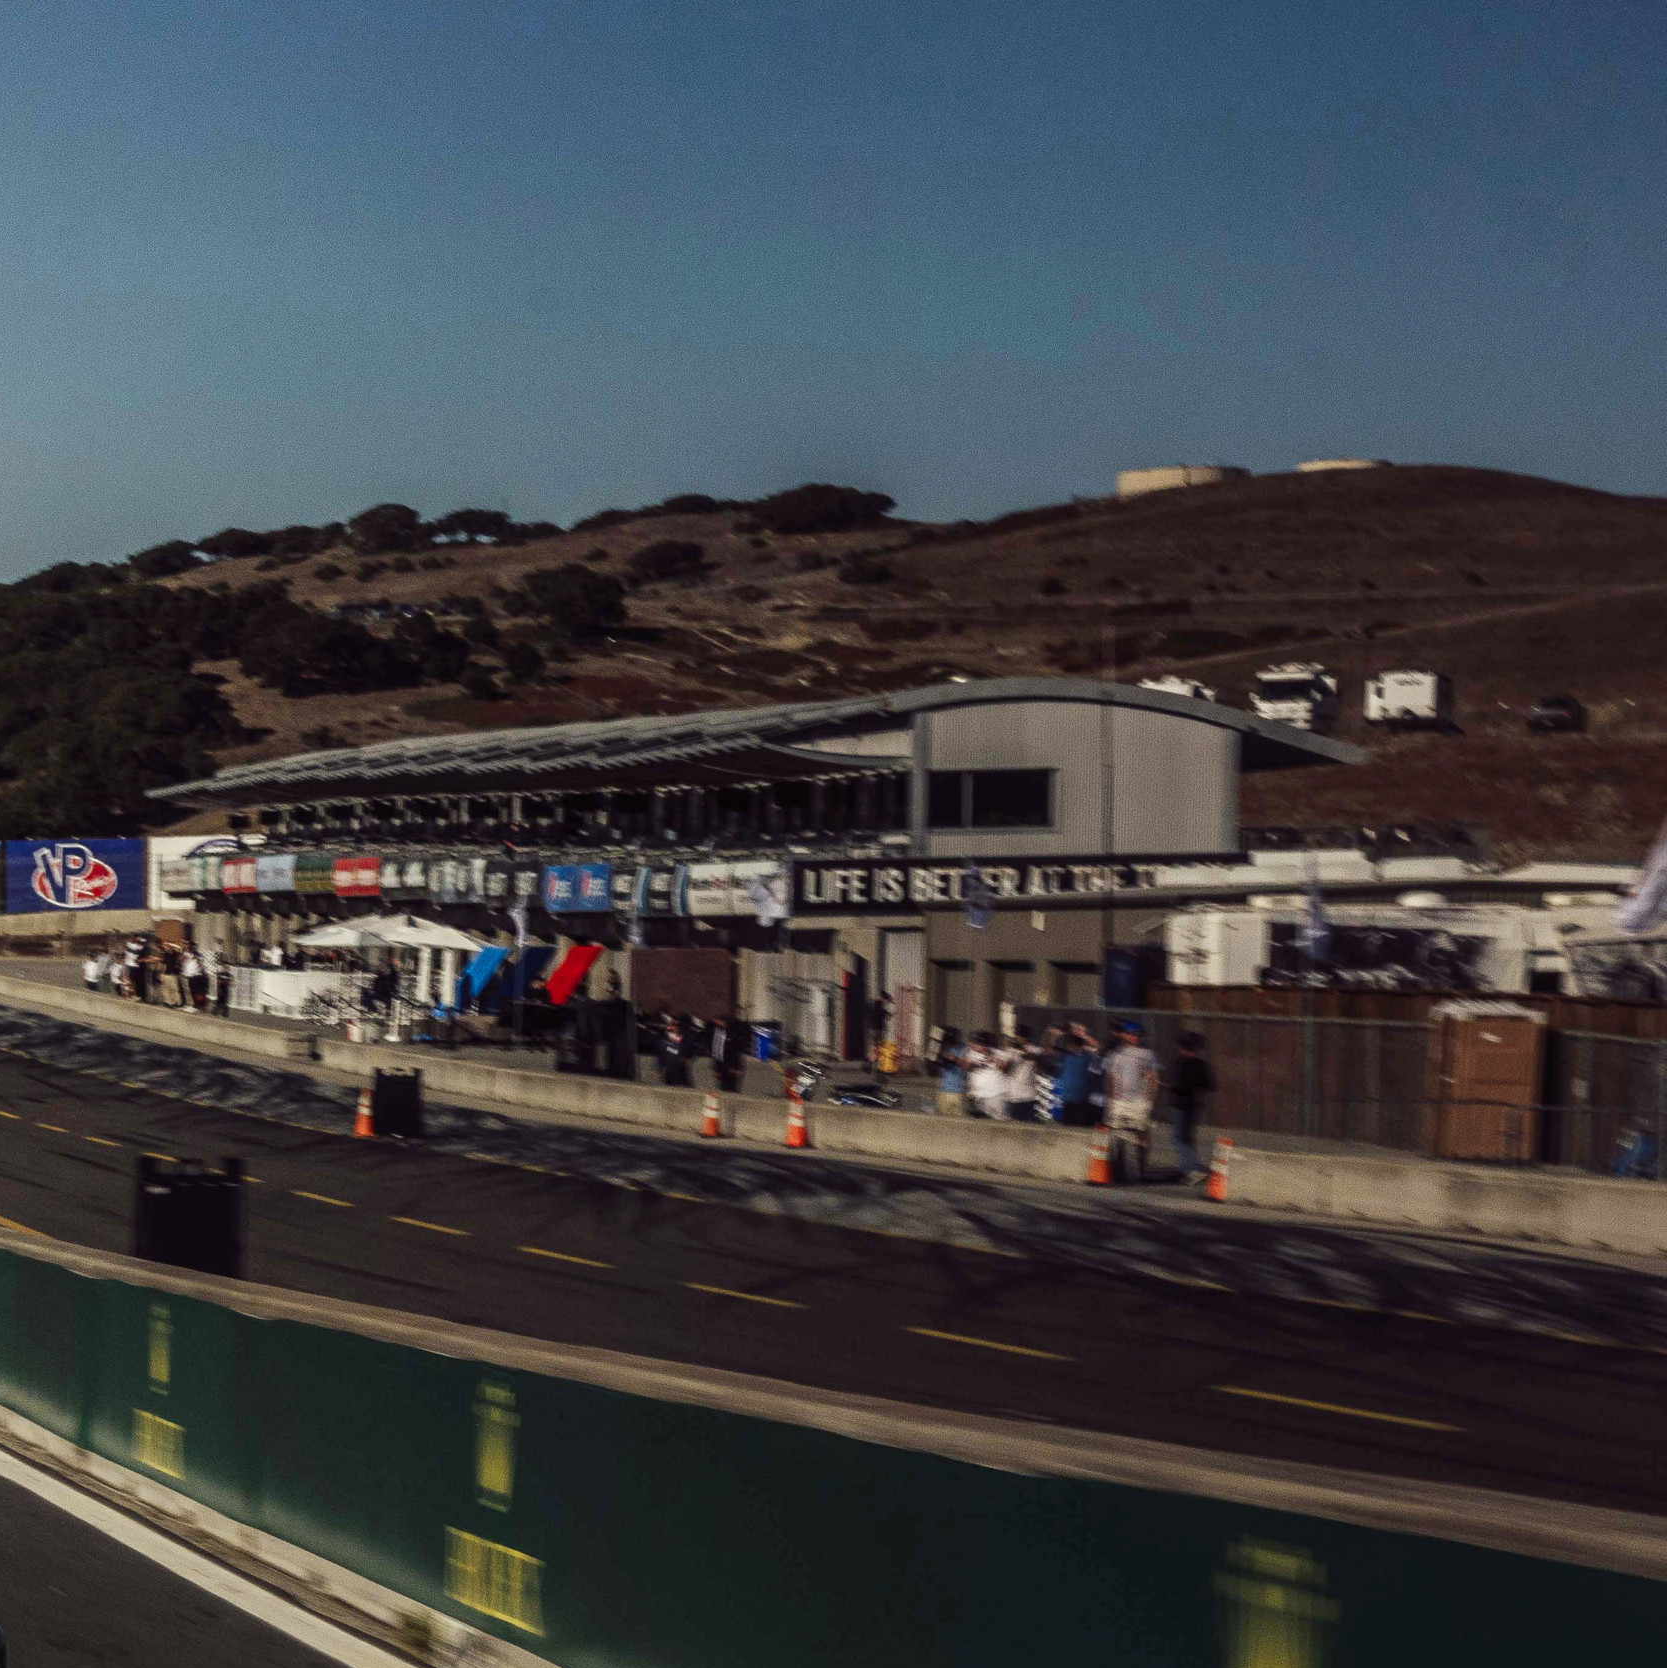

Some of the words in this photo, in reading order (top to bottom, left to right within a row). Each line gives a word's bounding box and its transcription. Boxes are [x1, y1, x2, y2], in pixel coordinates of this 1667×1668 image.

[803, 868, 867, 903] LIFE
[871, 868, 906, 902] IS
[1025, 864, 1066, 896] AT
